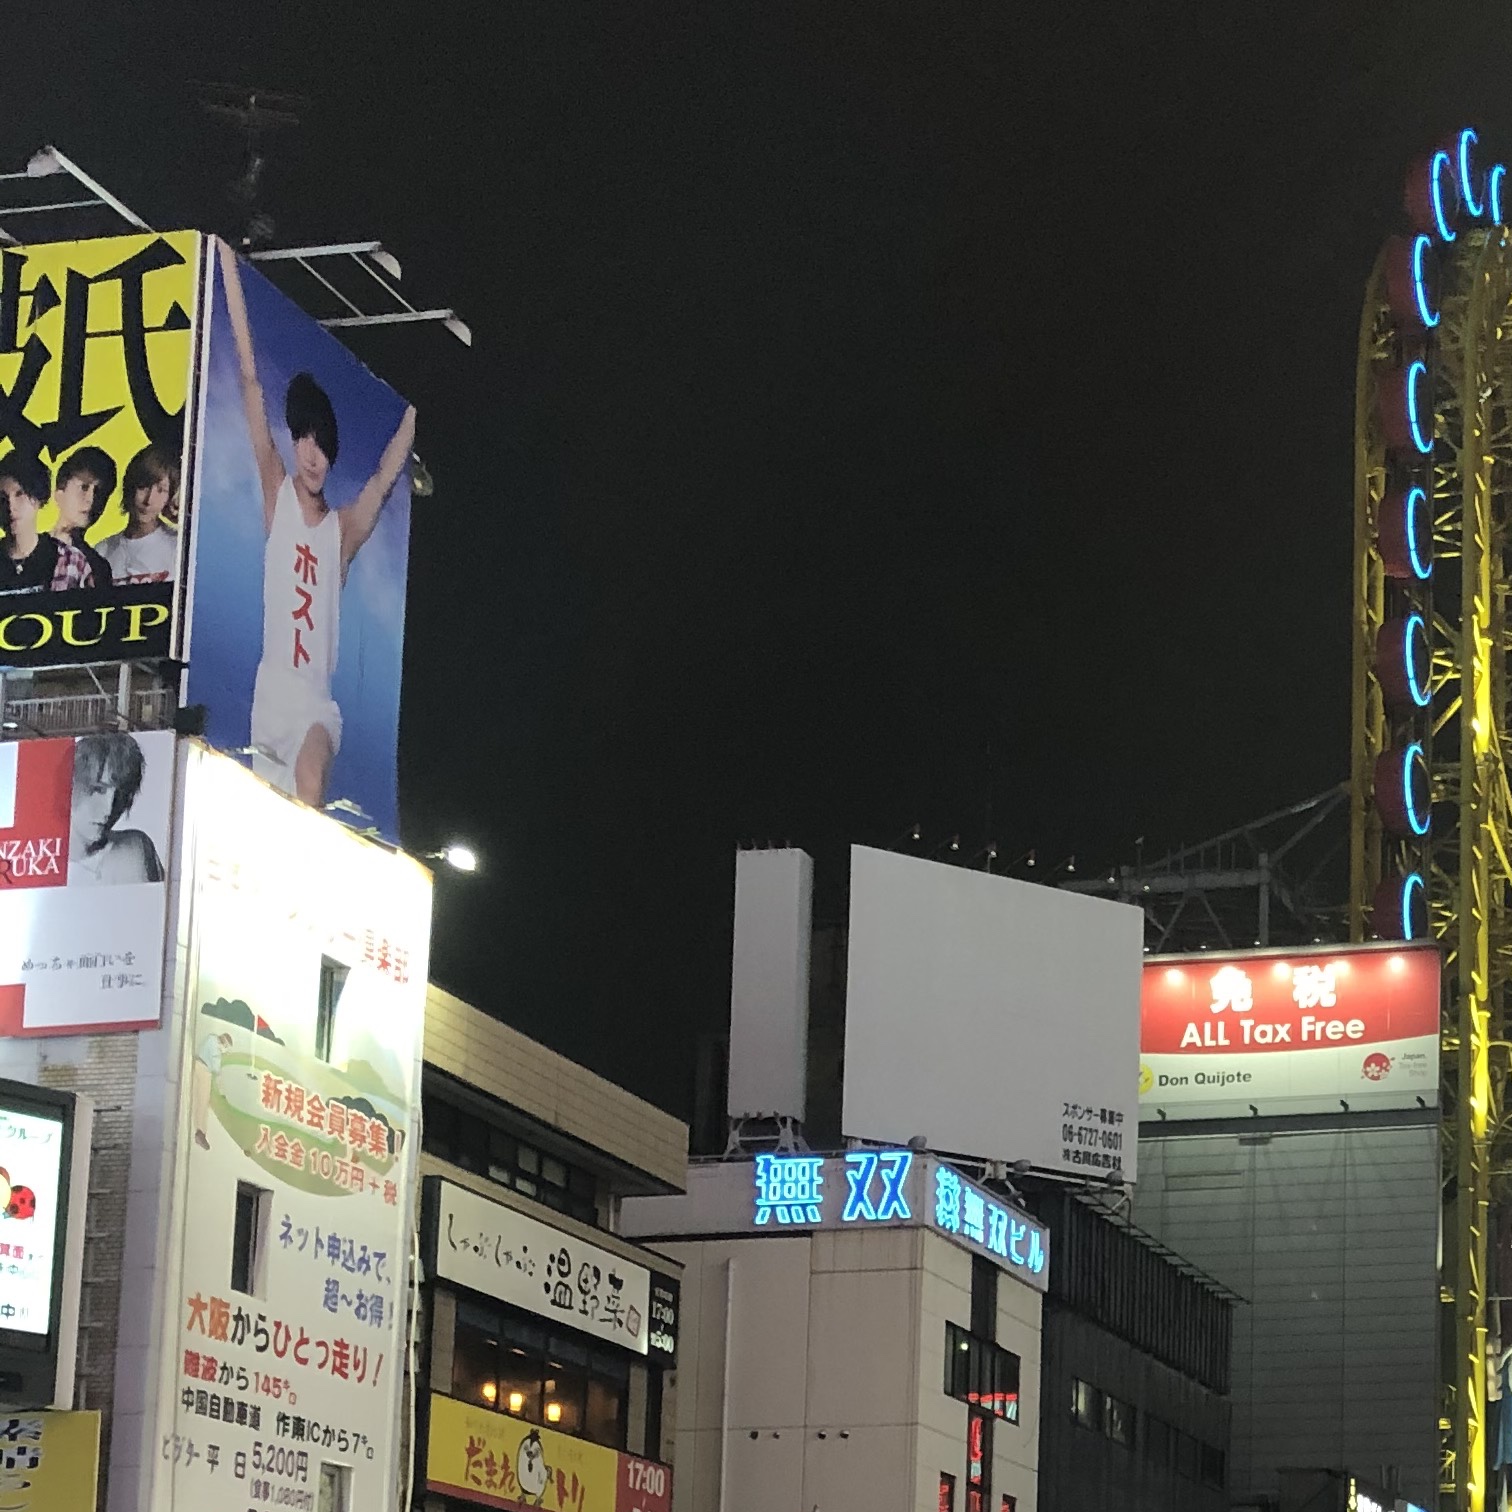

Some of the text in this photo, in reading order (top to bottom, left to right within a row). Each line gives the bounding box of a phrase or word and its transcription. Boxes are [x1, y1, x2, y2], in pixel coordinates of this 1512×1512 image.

[291, 543, 319, 669] ホスト
[1209, 965, 1338, 1014] 免税
[1179, 1016, 1366, 1048] ALL Tax Free
[1158, 1070, 1253, 1090] Don Quijote
[754, 1152, 912, 1225] 無双
[627, 1460, 665, 1497] 17:00
